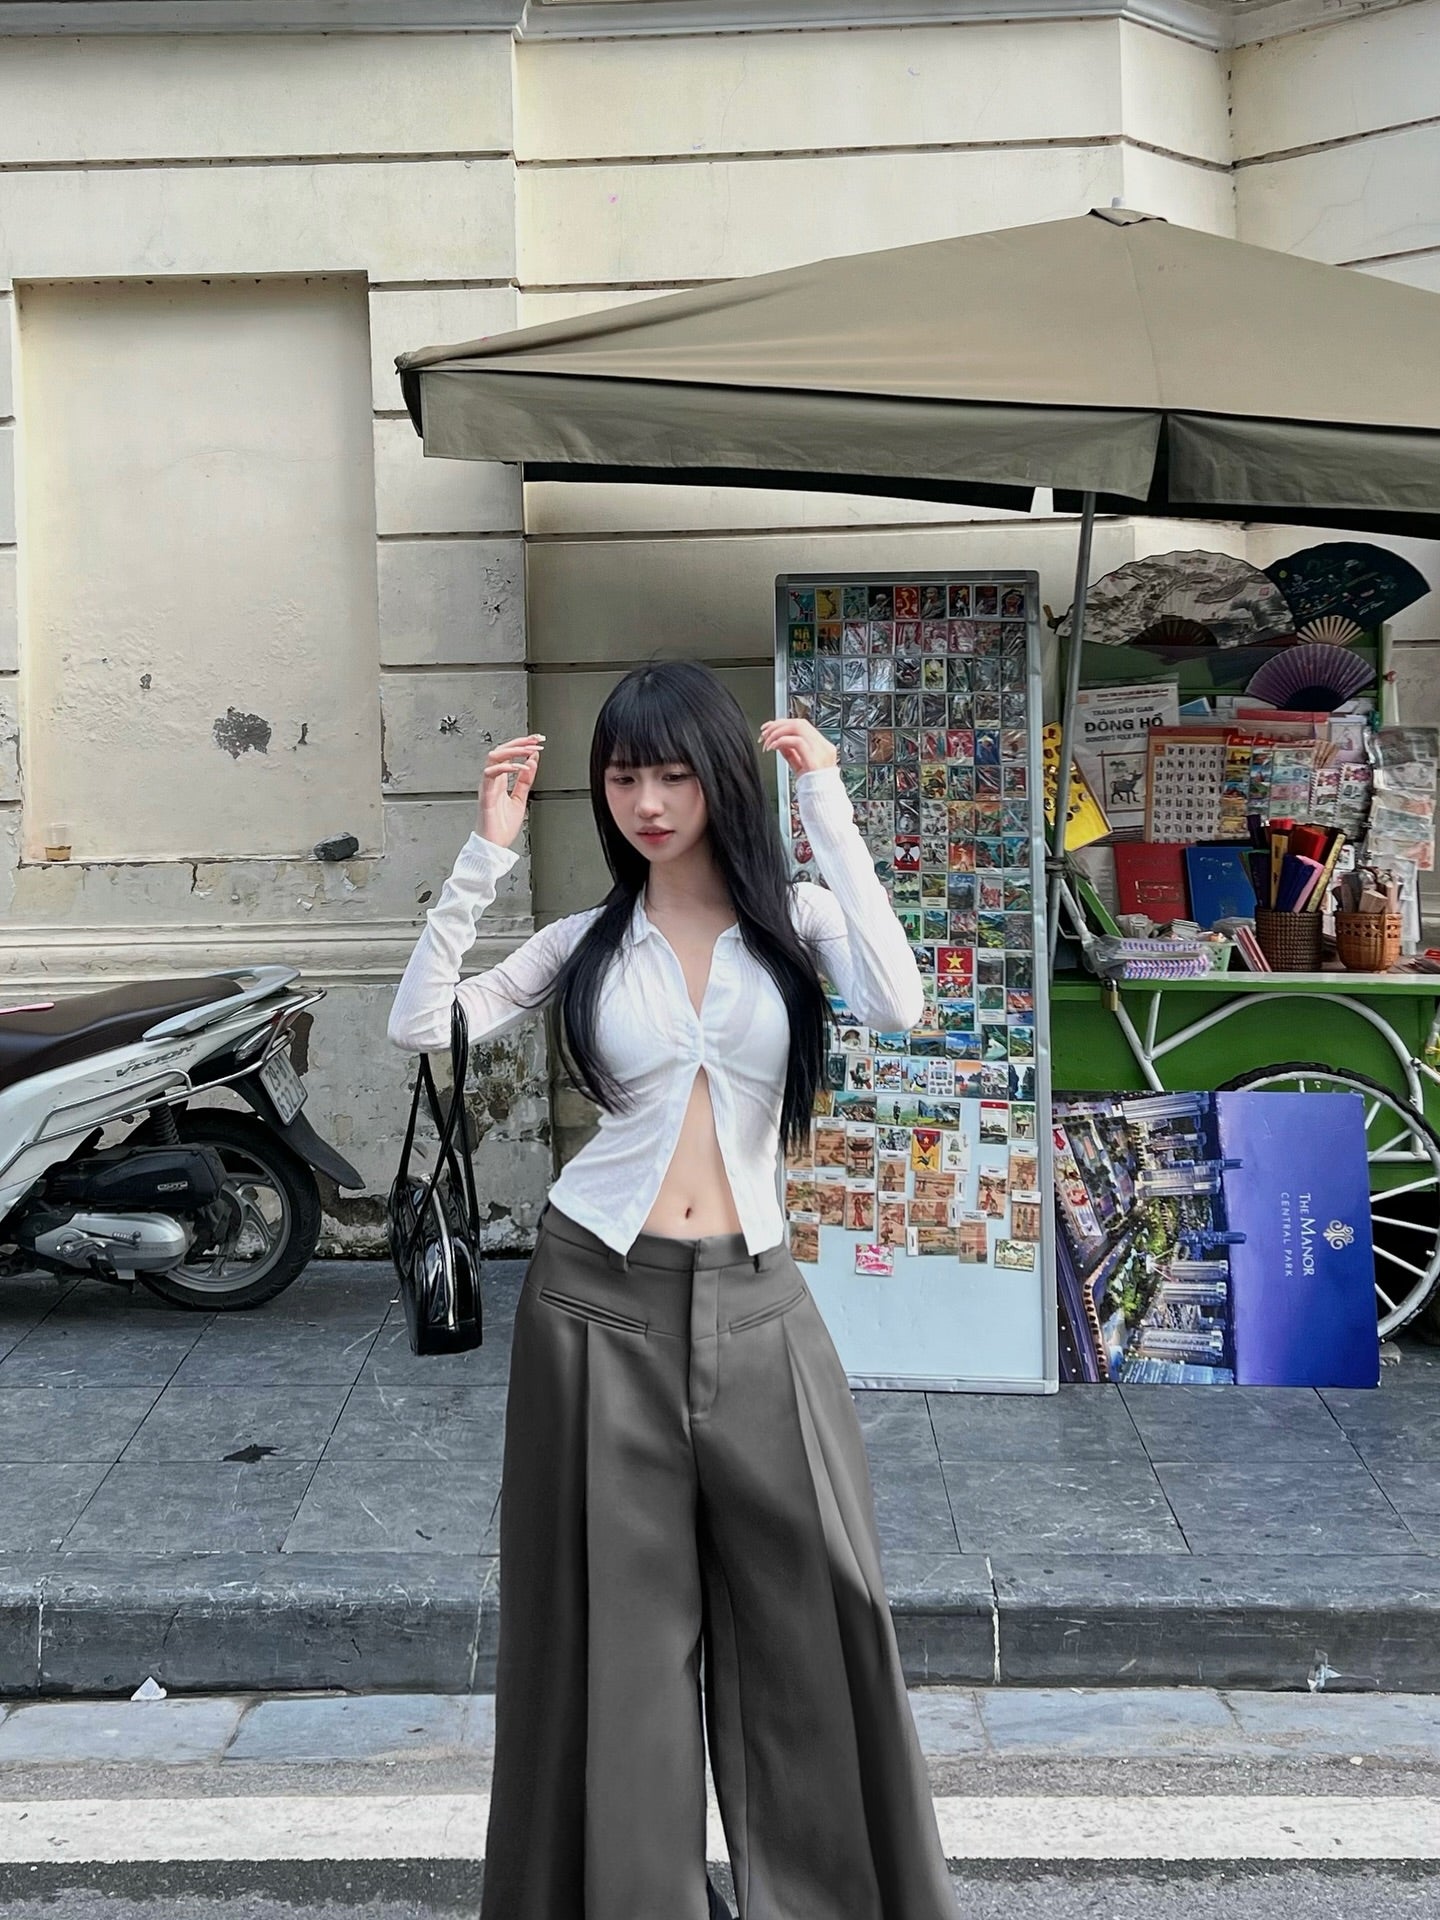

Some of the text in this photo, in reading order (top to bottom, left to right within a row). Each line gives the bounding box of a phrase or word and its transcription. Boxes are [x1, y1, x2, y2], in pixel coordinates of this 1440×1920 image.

[1084, 718, 1134, 733] ĐÔNG
[1092, 708, 1117, 716] TRANH
[1118, 706, 1134, 714] DÂN
[1281, 1192, 1294, 1277] CENTRAL PARK
[1298, 1192, 1317, 1276] THE MANOR
